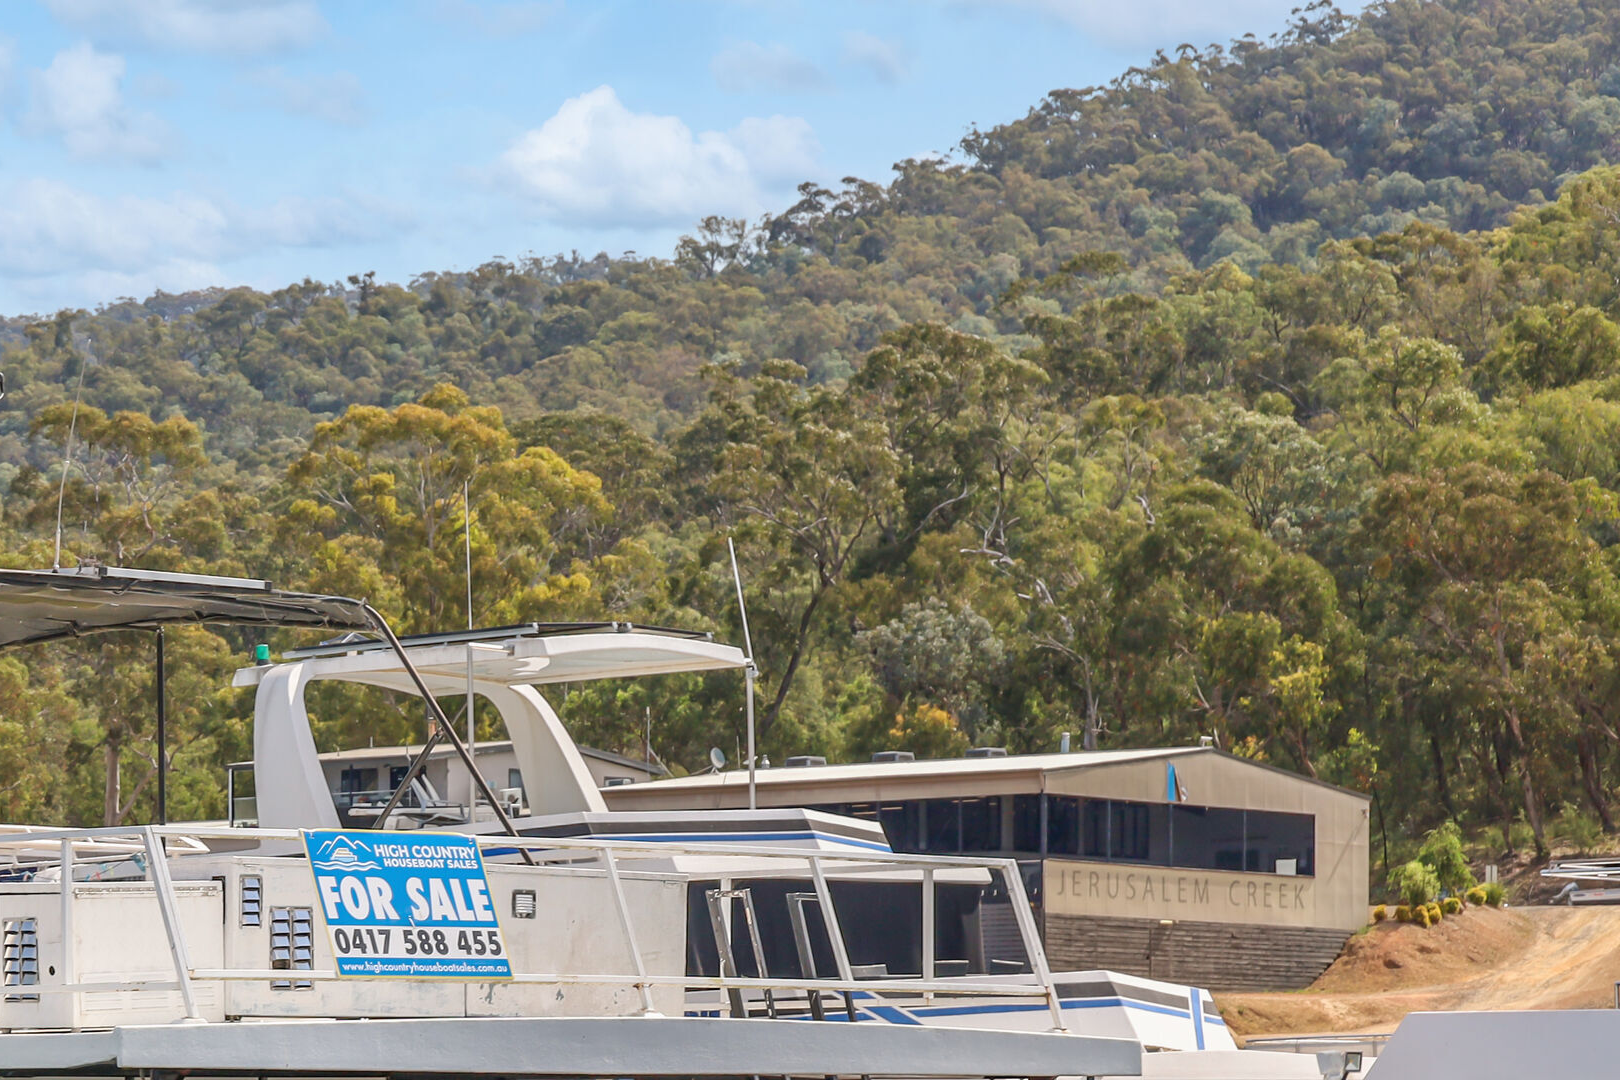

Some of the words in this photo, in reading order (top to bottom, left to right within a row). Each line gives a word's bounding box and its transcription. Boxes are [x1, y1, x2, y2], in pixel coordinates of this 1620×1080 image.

[373, 844, 410, 858] HIGH
[411, 844, 476, 860] COUNTRY
[383, 858, 445, 869] HOUSEBOAT
[446, 859, 479, 869] SALES
[318, 875, 400, 921] FOR
[406, 876, 496, 922] SALE
[1057, 869, 1210, 905] JERUSALEM
[1229, 880, 1306, 910] CREEK
[334, 928, 391, 955] 0417
[402, 929, 450, 956] 588
[457, 930, 503, 956] 455
[341, 961, 508, 974] www.highcountryhouseboatsales.com.au
